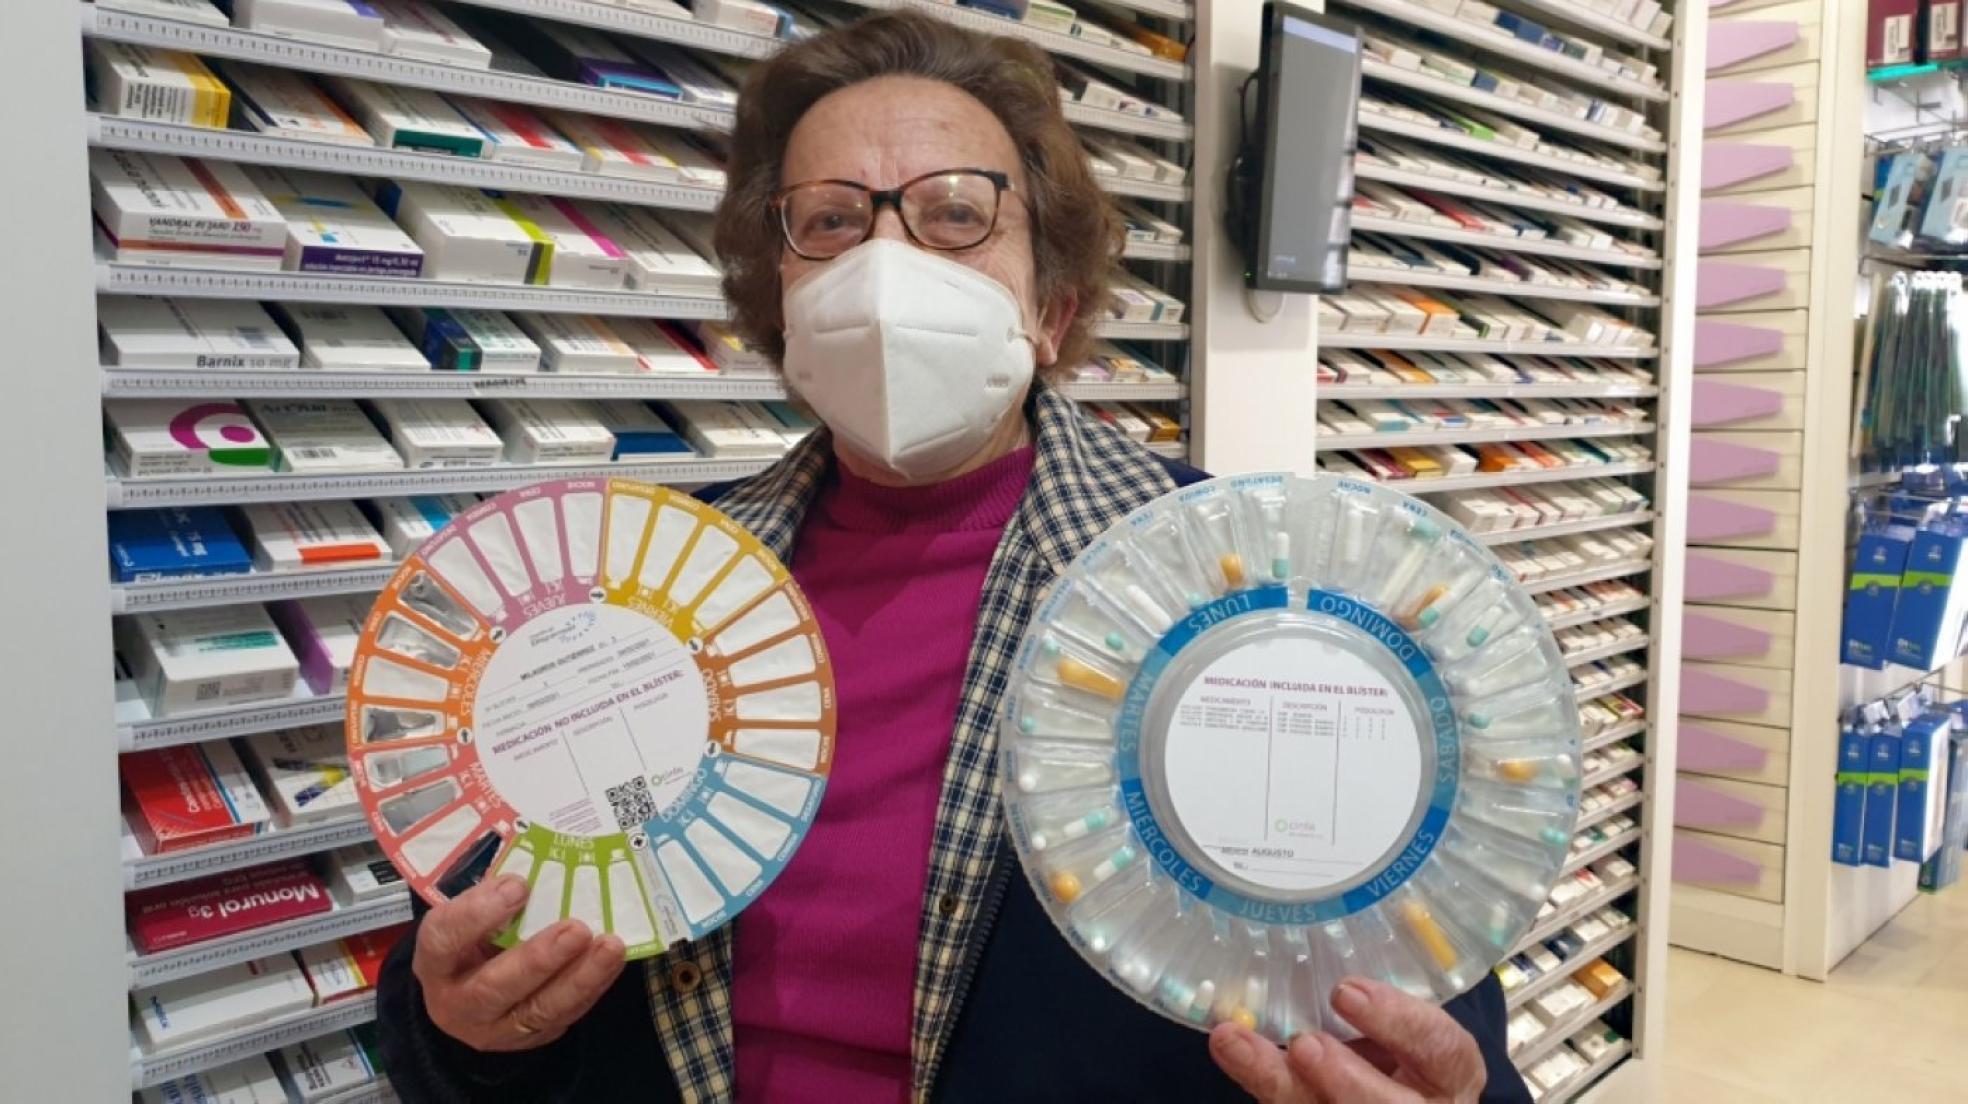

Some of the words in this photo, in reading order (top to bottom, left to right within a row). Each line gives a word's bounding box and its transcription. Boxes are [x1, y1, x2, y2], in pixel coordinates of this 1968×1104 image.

[196, 355, 245, 368] Barnix
[522, 593, 567, 618] JUEVES
[1187, 593, 1251, 632] LUNES
[1319, 596, 1416, 662] DOMINGO
[1204, 675, 1267, 690] MEDICACIÓN
[1269, 681, 1316, 694] INCLUIDA
[1318, 684, 1332, 694] EN
[1333, 685, 1345, 695] EL
[491, 723, 552, 756] MEDICACIÓN
[555, 715, 571, 729] NO
[570, 696, 616, 724] INCLUIDA
[615, 690, 631, 704] EN
[629, 686, 643, 700] EL
[1119, 669, 1157, 752] MARTES
[1125, 790, 1202, 892] MIERCOLES
[1364, 829, 1436, 898] VIERNES
[187, 904, 215, 920] 3g
[218, 882, 320, 919] Monurol
[1238, 902, 1317, 923] JUEVES
